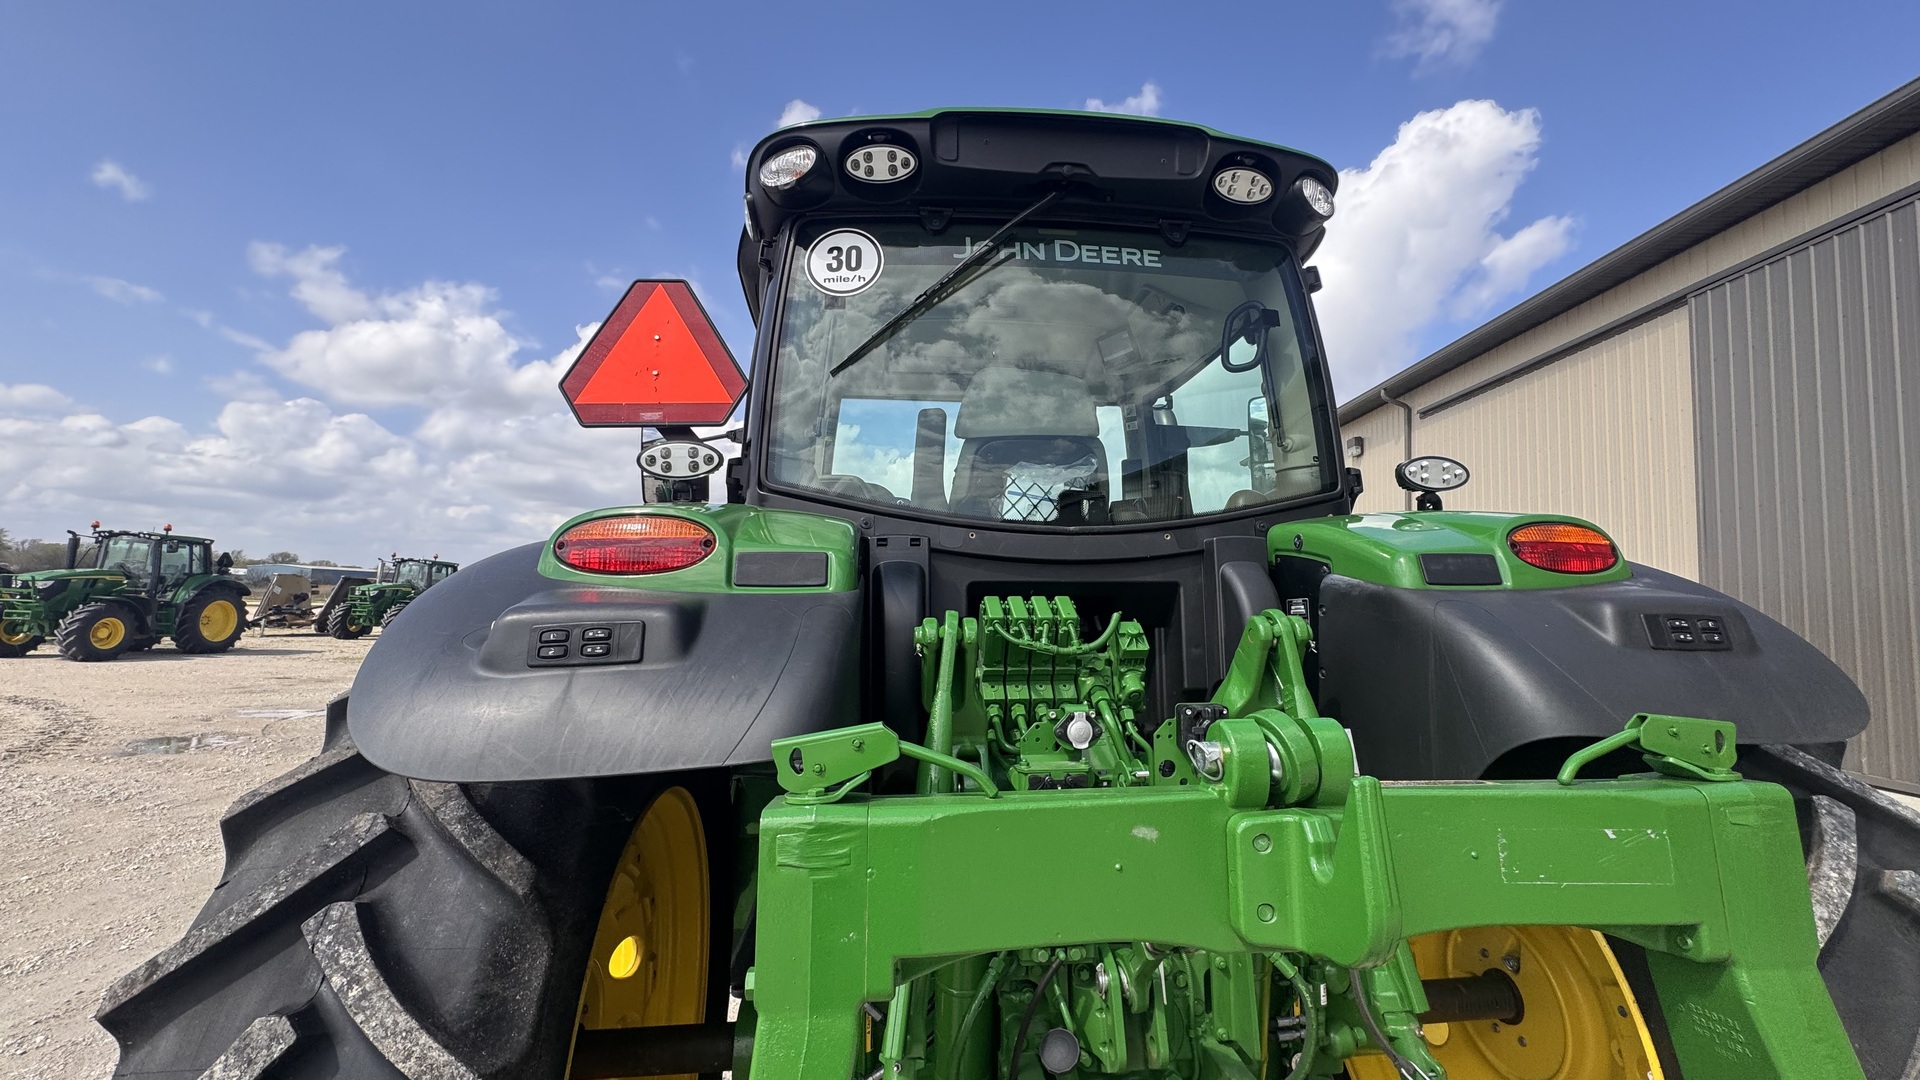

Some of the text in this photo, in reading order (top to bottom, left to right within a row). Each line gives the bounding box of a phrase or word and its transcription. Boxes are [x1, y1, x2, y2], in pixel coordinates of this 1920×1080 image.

[826, 245, 862, 272] 30
[1054, 239, 1162, 268] DEERE
[823, 274, 866, 283] mile/h
